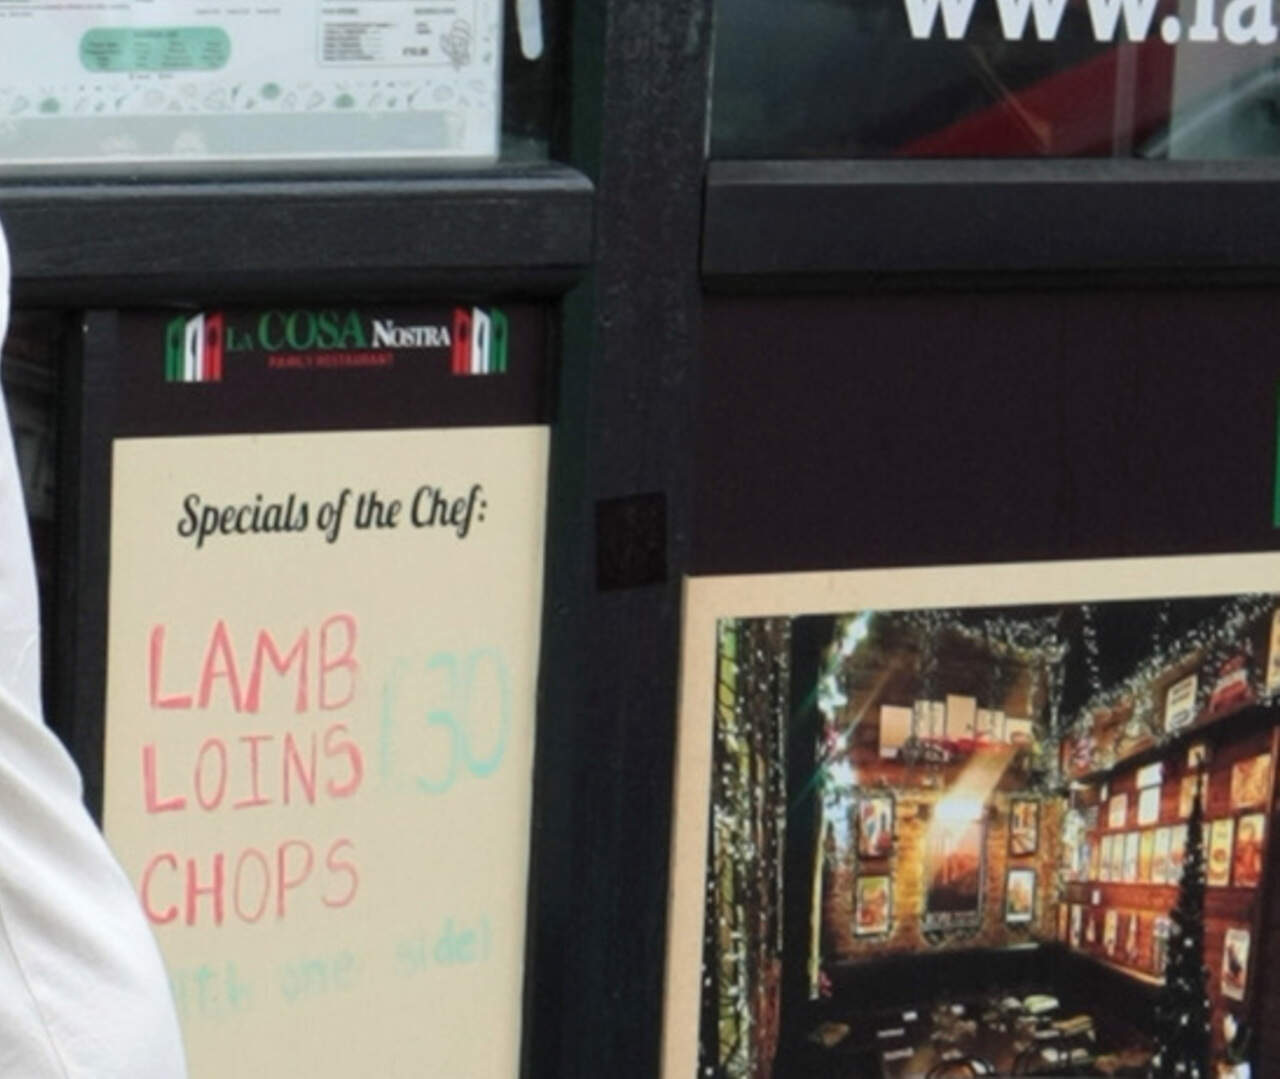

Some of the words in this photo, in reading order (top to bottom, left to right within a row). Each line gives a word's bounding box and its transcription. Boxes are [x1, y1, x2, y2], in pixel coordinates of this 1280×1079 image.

[258, 308, 367, 351] COSA
[177, 493, 309, 549] Specials
[316, 488, 350, 544] of
[354, 489, 403, 531] the
[410, 484, 488, 539] Chef:
[148, 613, 359, 715] LAMB
[142, 723, 364, 815] LOINS
[140, 838, 360, 927] CHOPS
